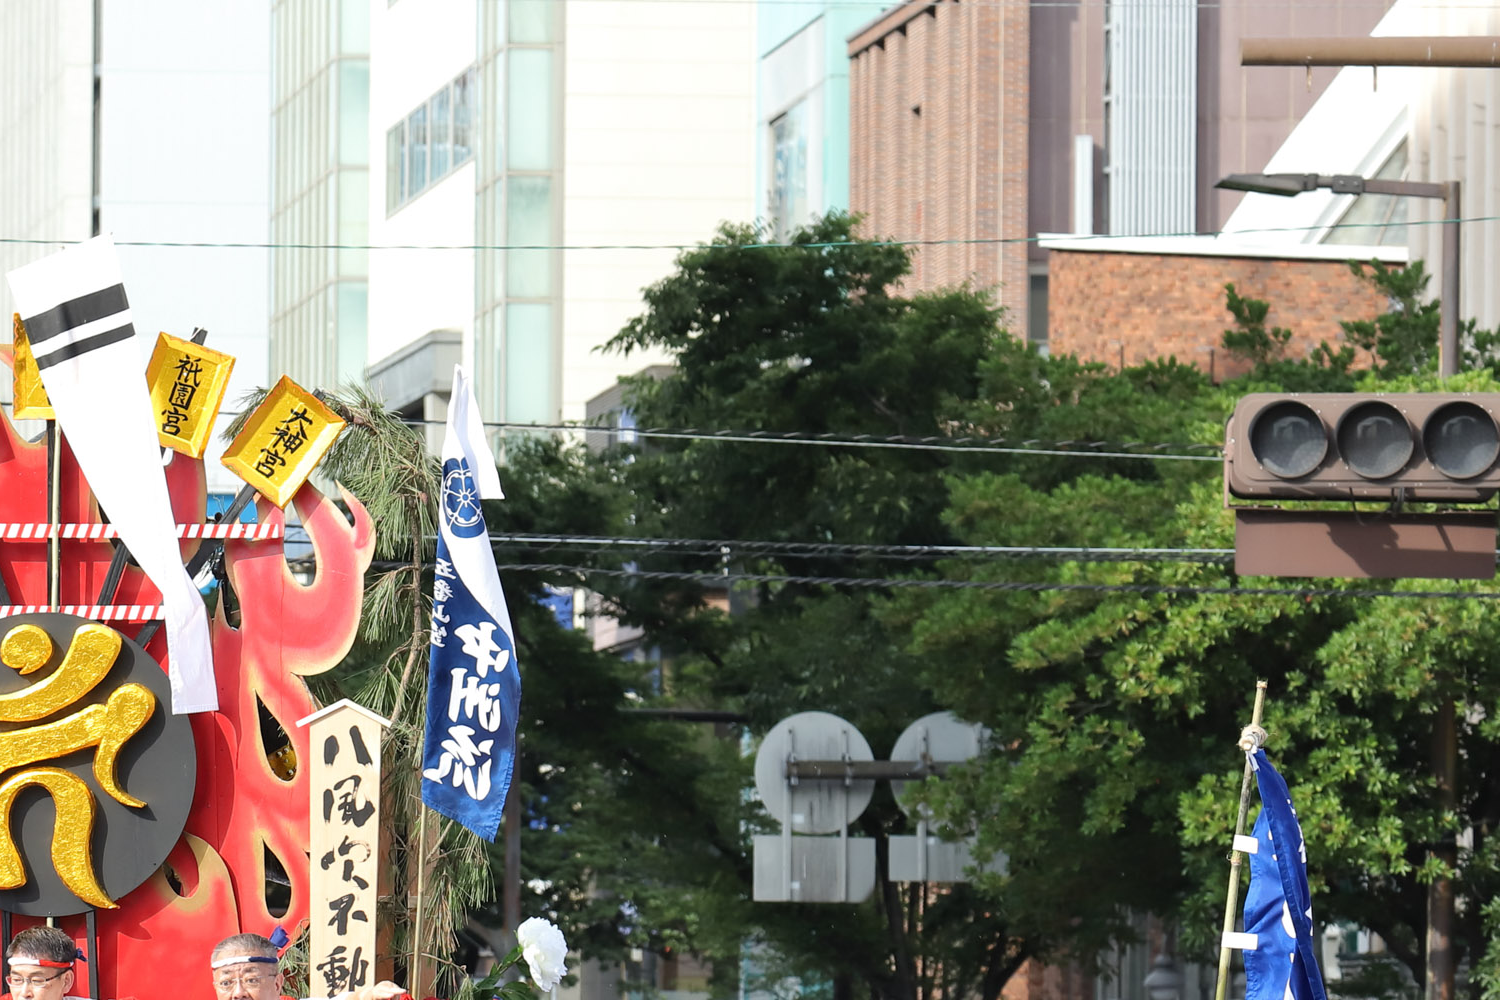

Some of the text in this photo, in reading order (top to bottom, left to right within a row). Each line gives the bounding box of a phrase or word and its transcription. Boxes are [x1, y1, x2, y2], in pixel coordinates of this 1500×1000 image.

[161, 354, 203, 436] 祇園宮
[255, 408, 314, 479] 大神宮
